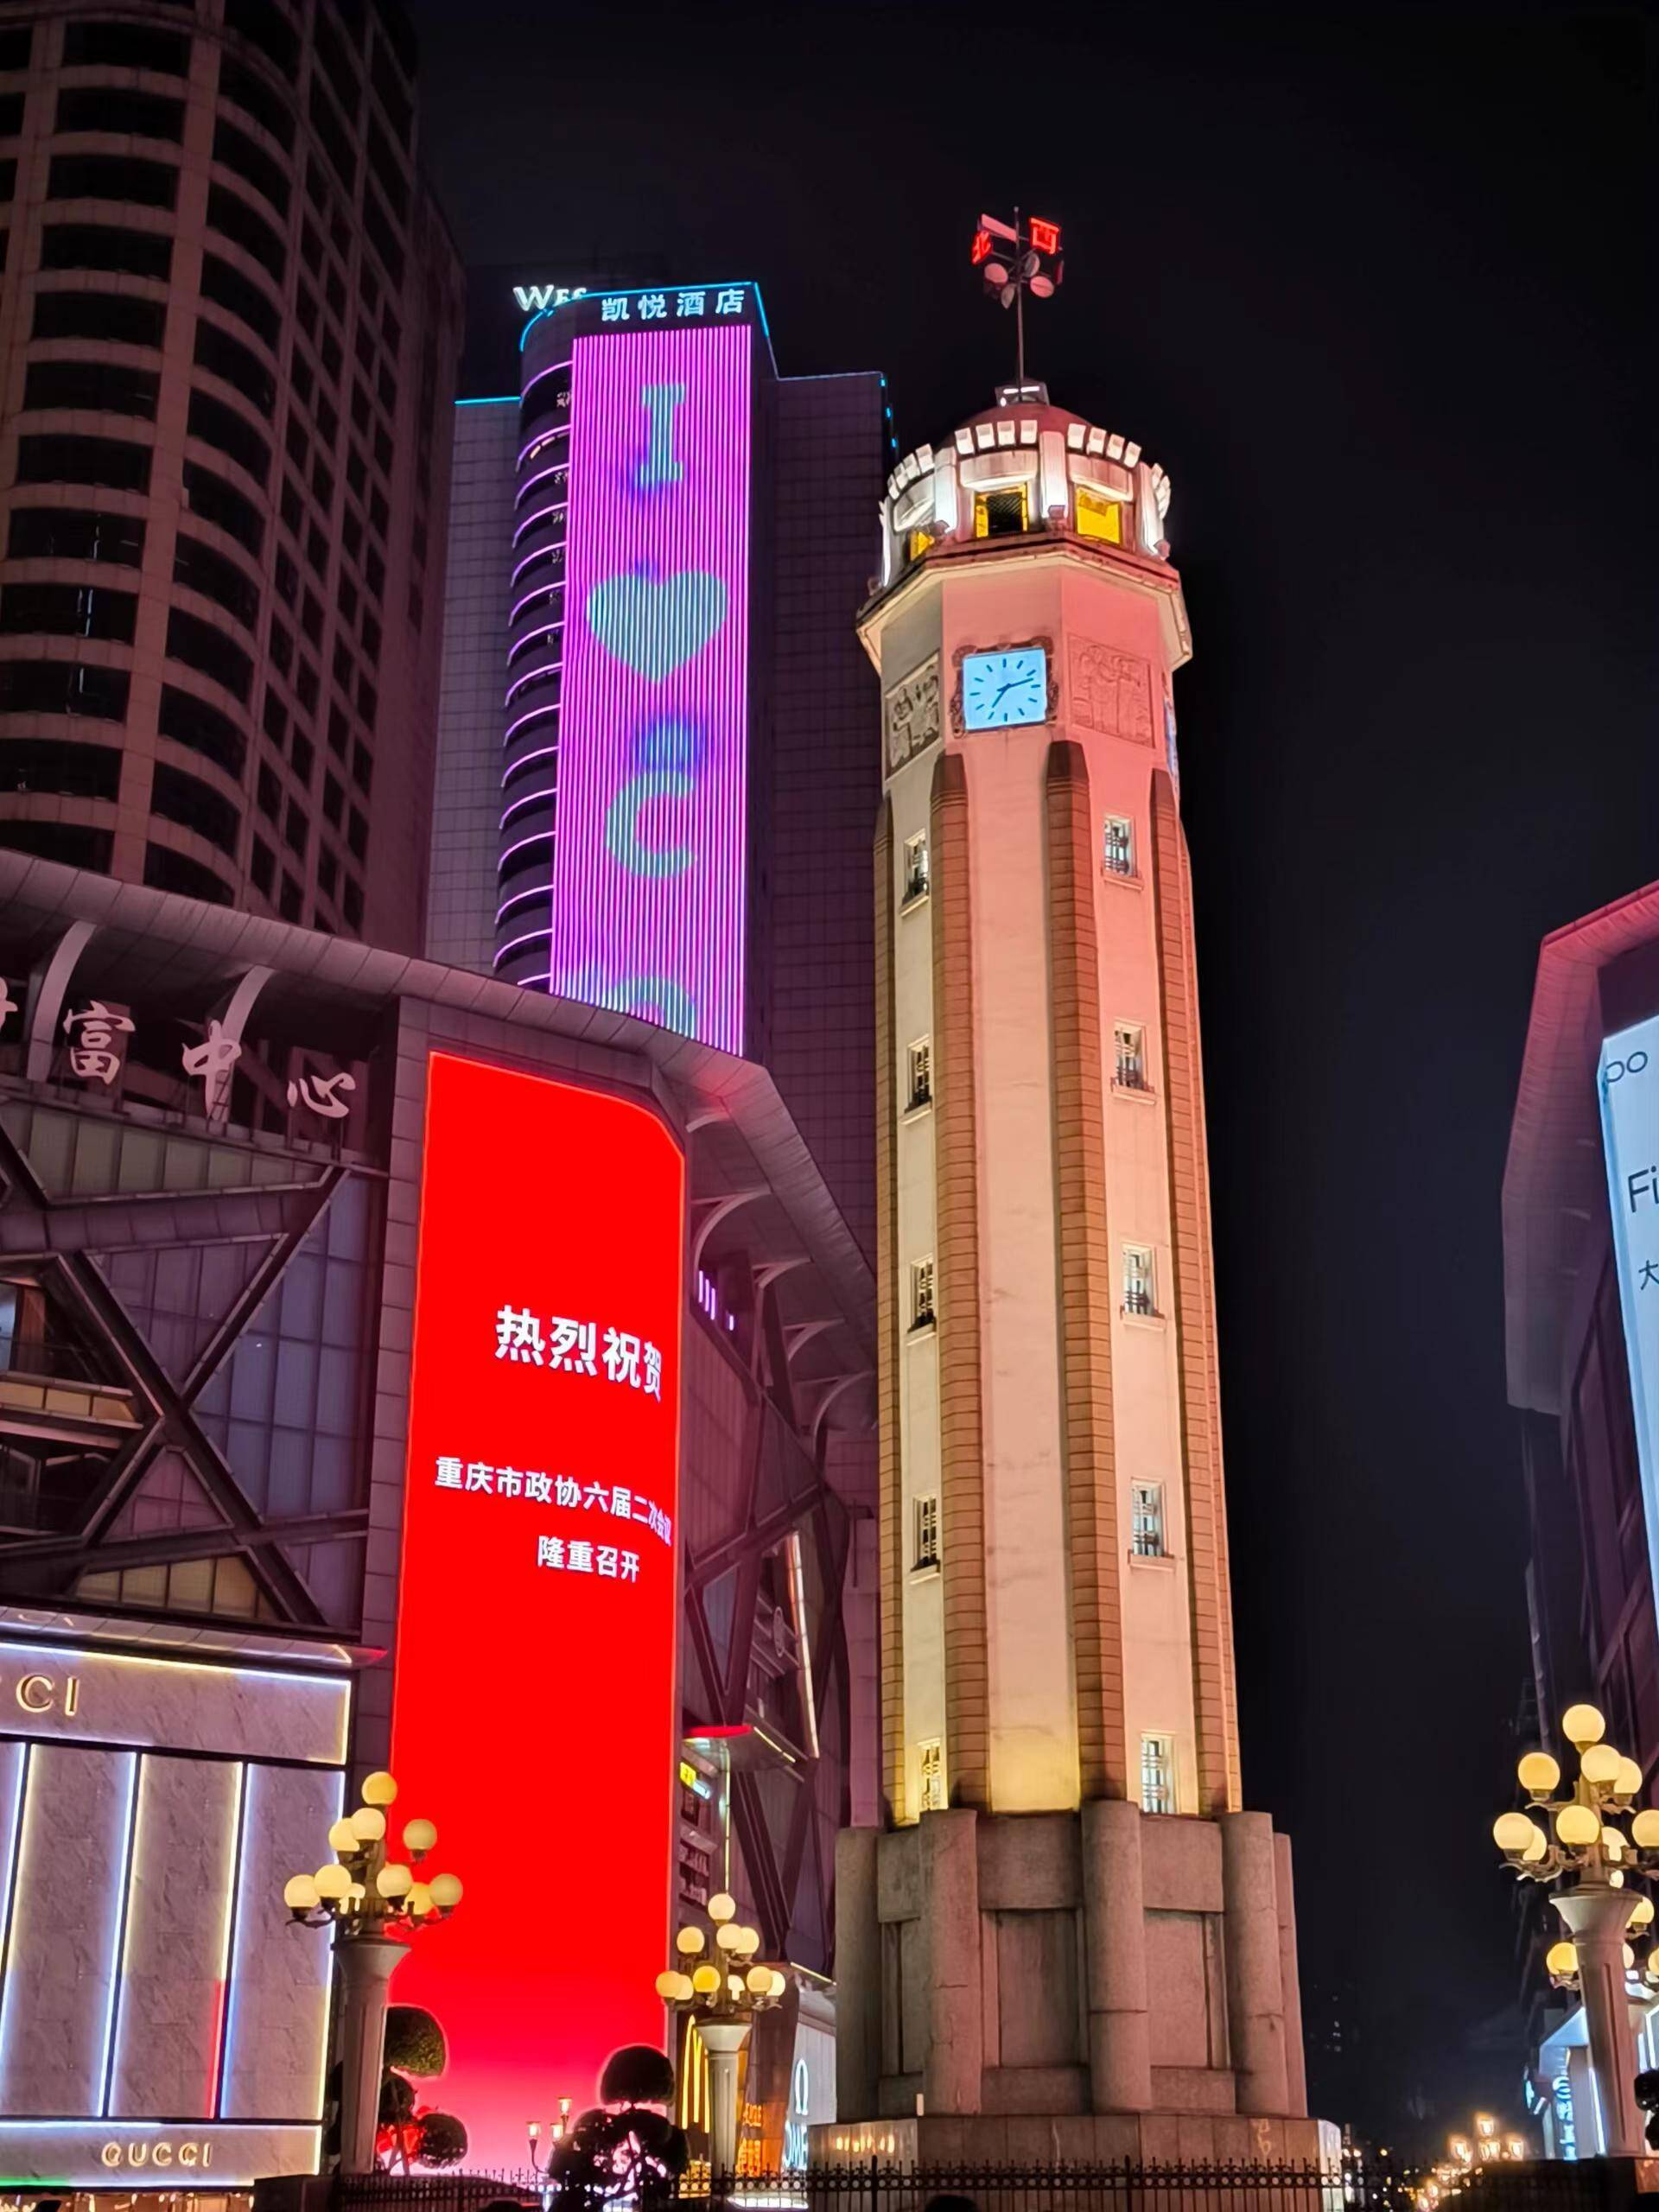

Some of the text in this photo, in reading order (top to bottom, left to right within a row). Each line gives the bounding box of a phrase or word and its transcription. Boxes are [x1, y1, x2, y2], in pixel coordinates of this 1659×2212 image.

[601, 289, 745, 322] 凯悦酒店
[0, 976, 357, 1120] 富中心
[493, 1305, 663, 1402] 热烈祝贺
[537, 1535, 640, 1583] 隆重召开
[101, 2141, 213, 2168] GUCCI
